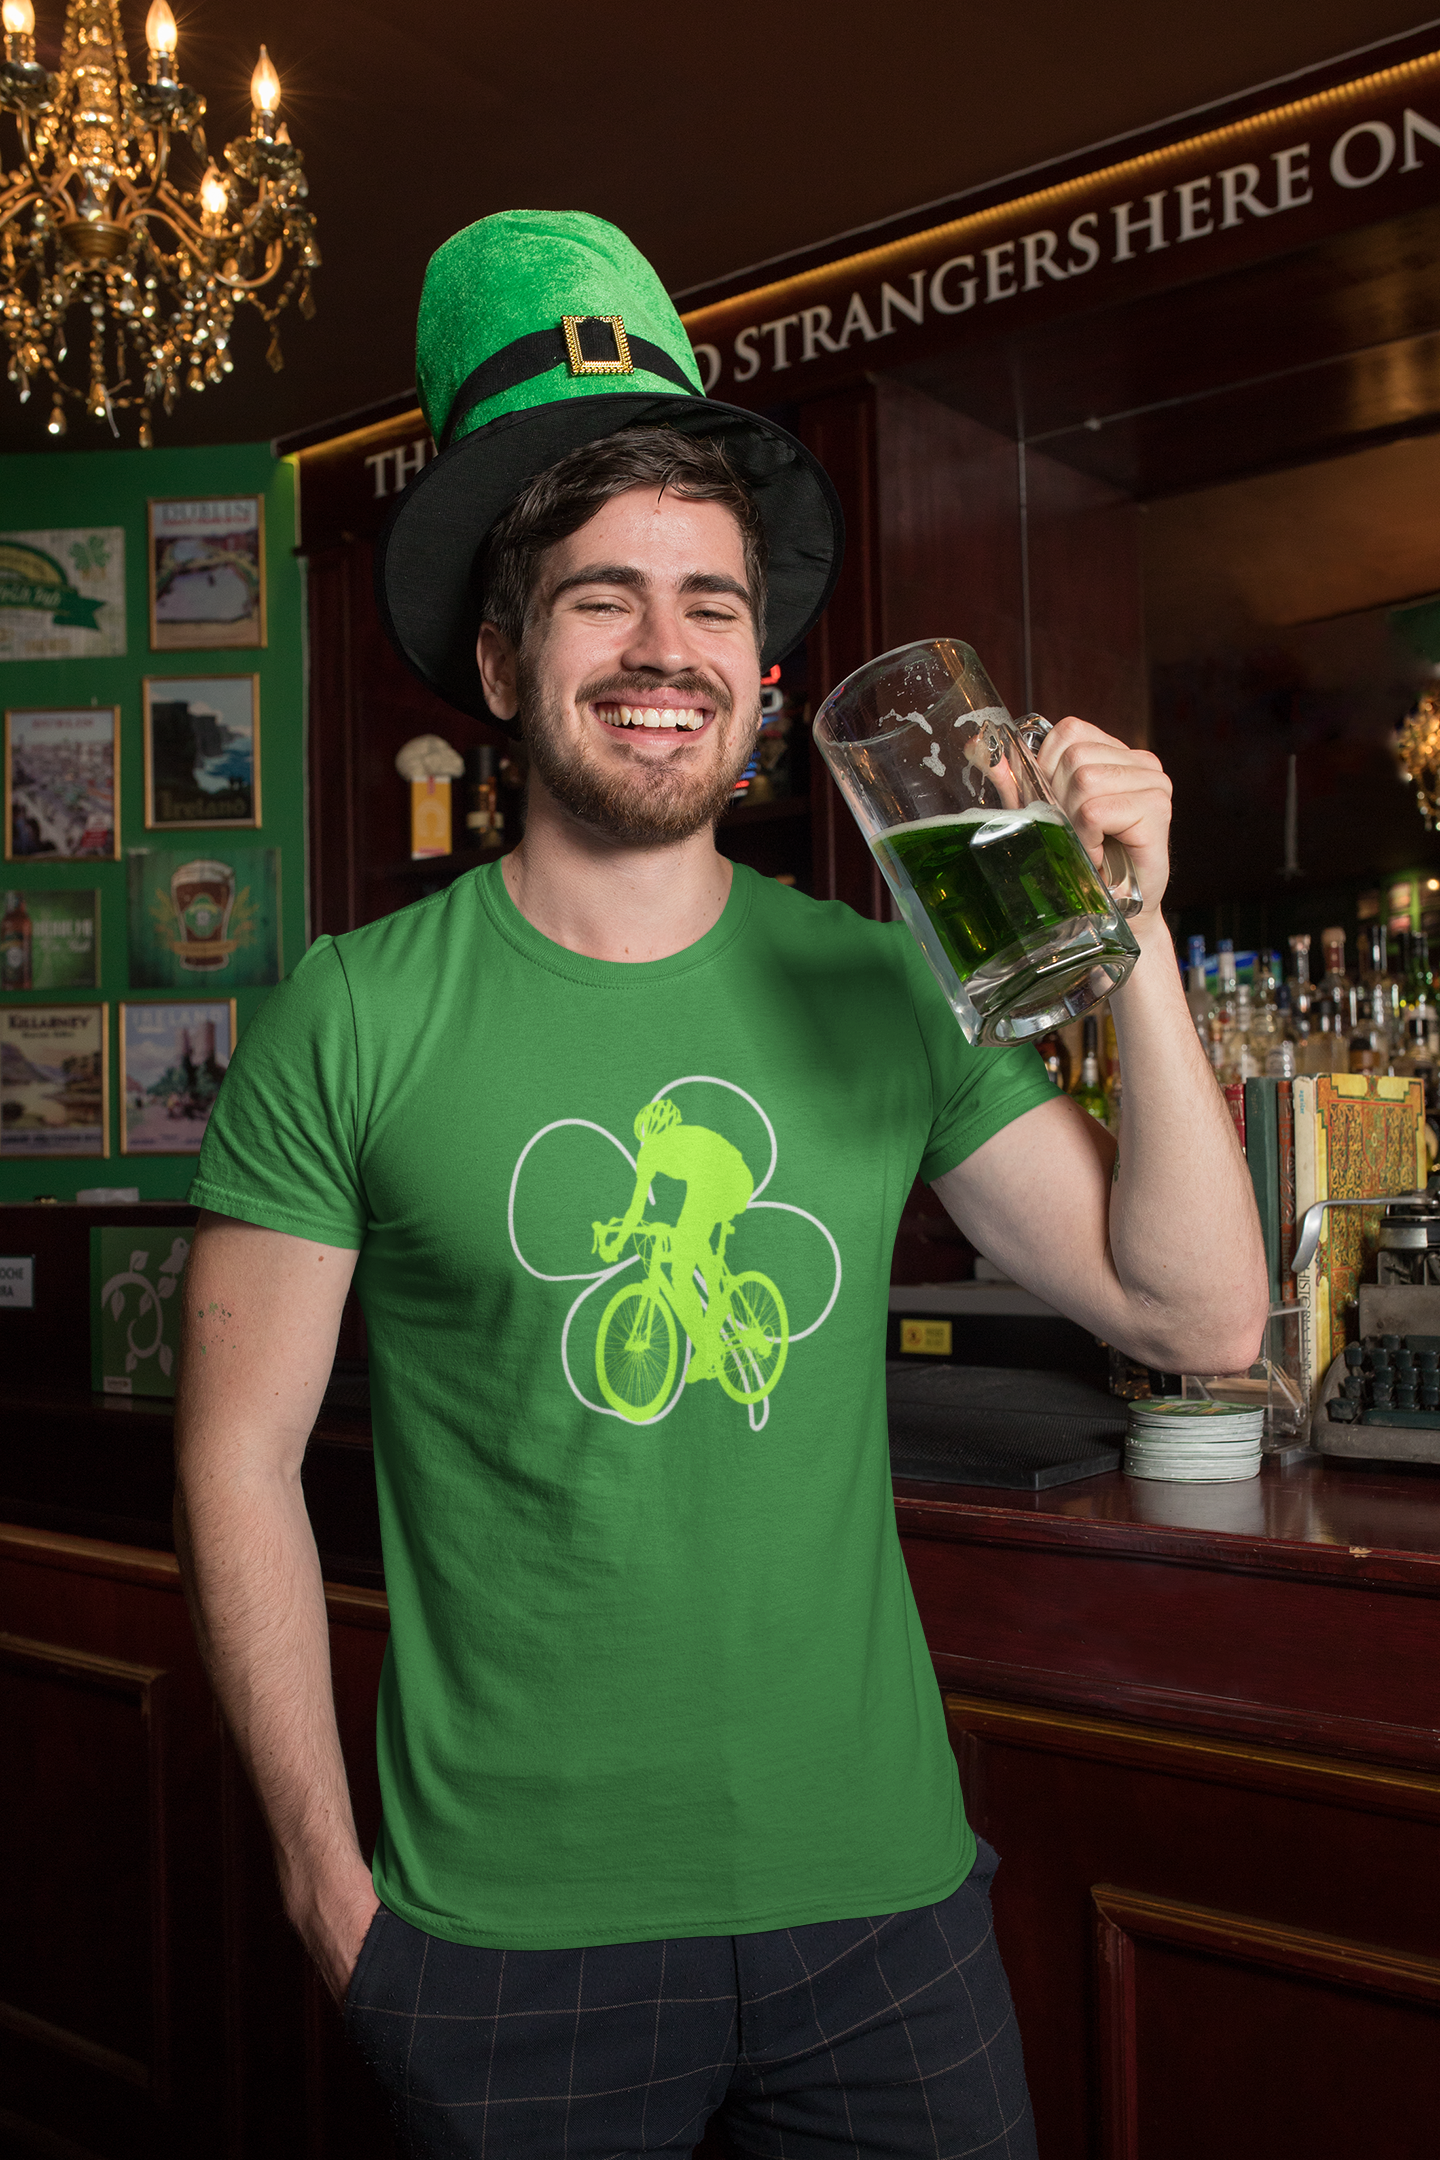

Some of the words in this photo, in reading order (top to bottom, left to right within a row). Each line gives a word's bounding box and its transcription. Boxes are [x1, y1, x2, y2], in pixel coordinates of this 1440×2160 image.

[364, 436, 438, 499] TH
[733, 211, 1100, 382] STRANGERS
[1110, 143, 1313, 264] HERE
[1282, 1233, 1291, 1282] Historia
